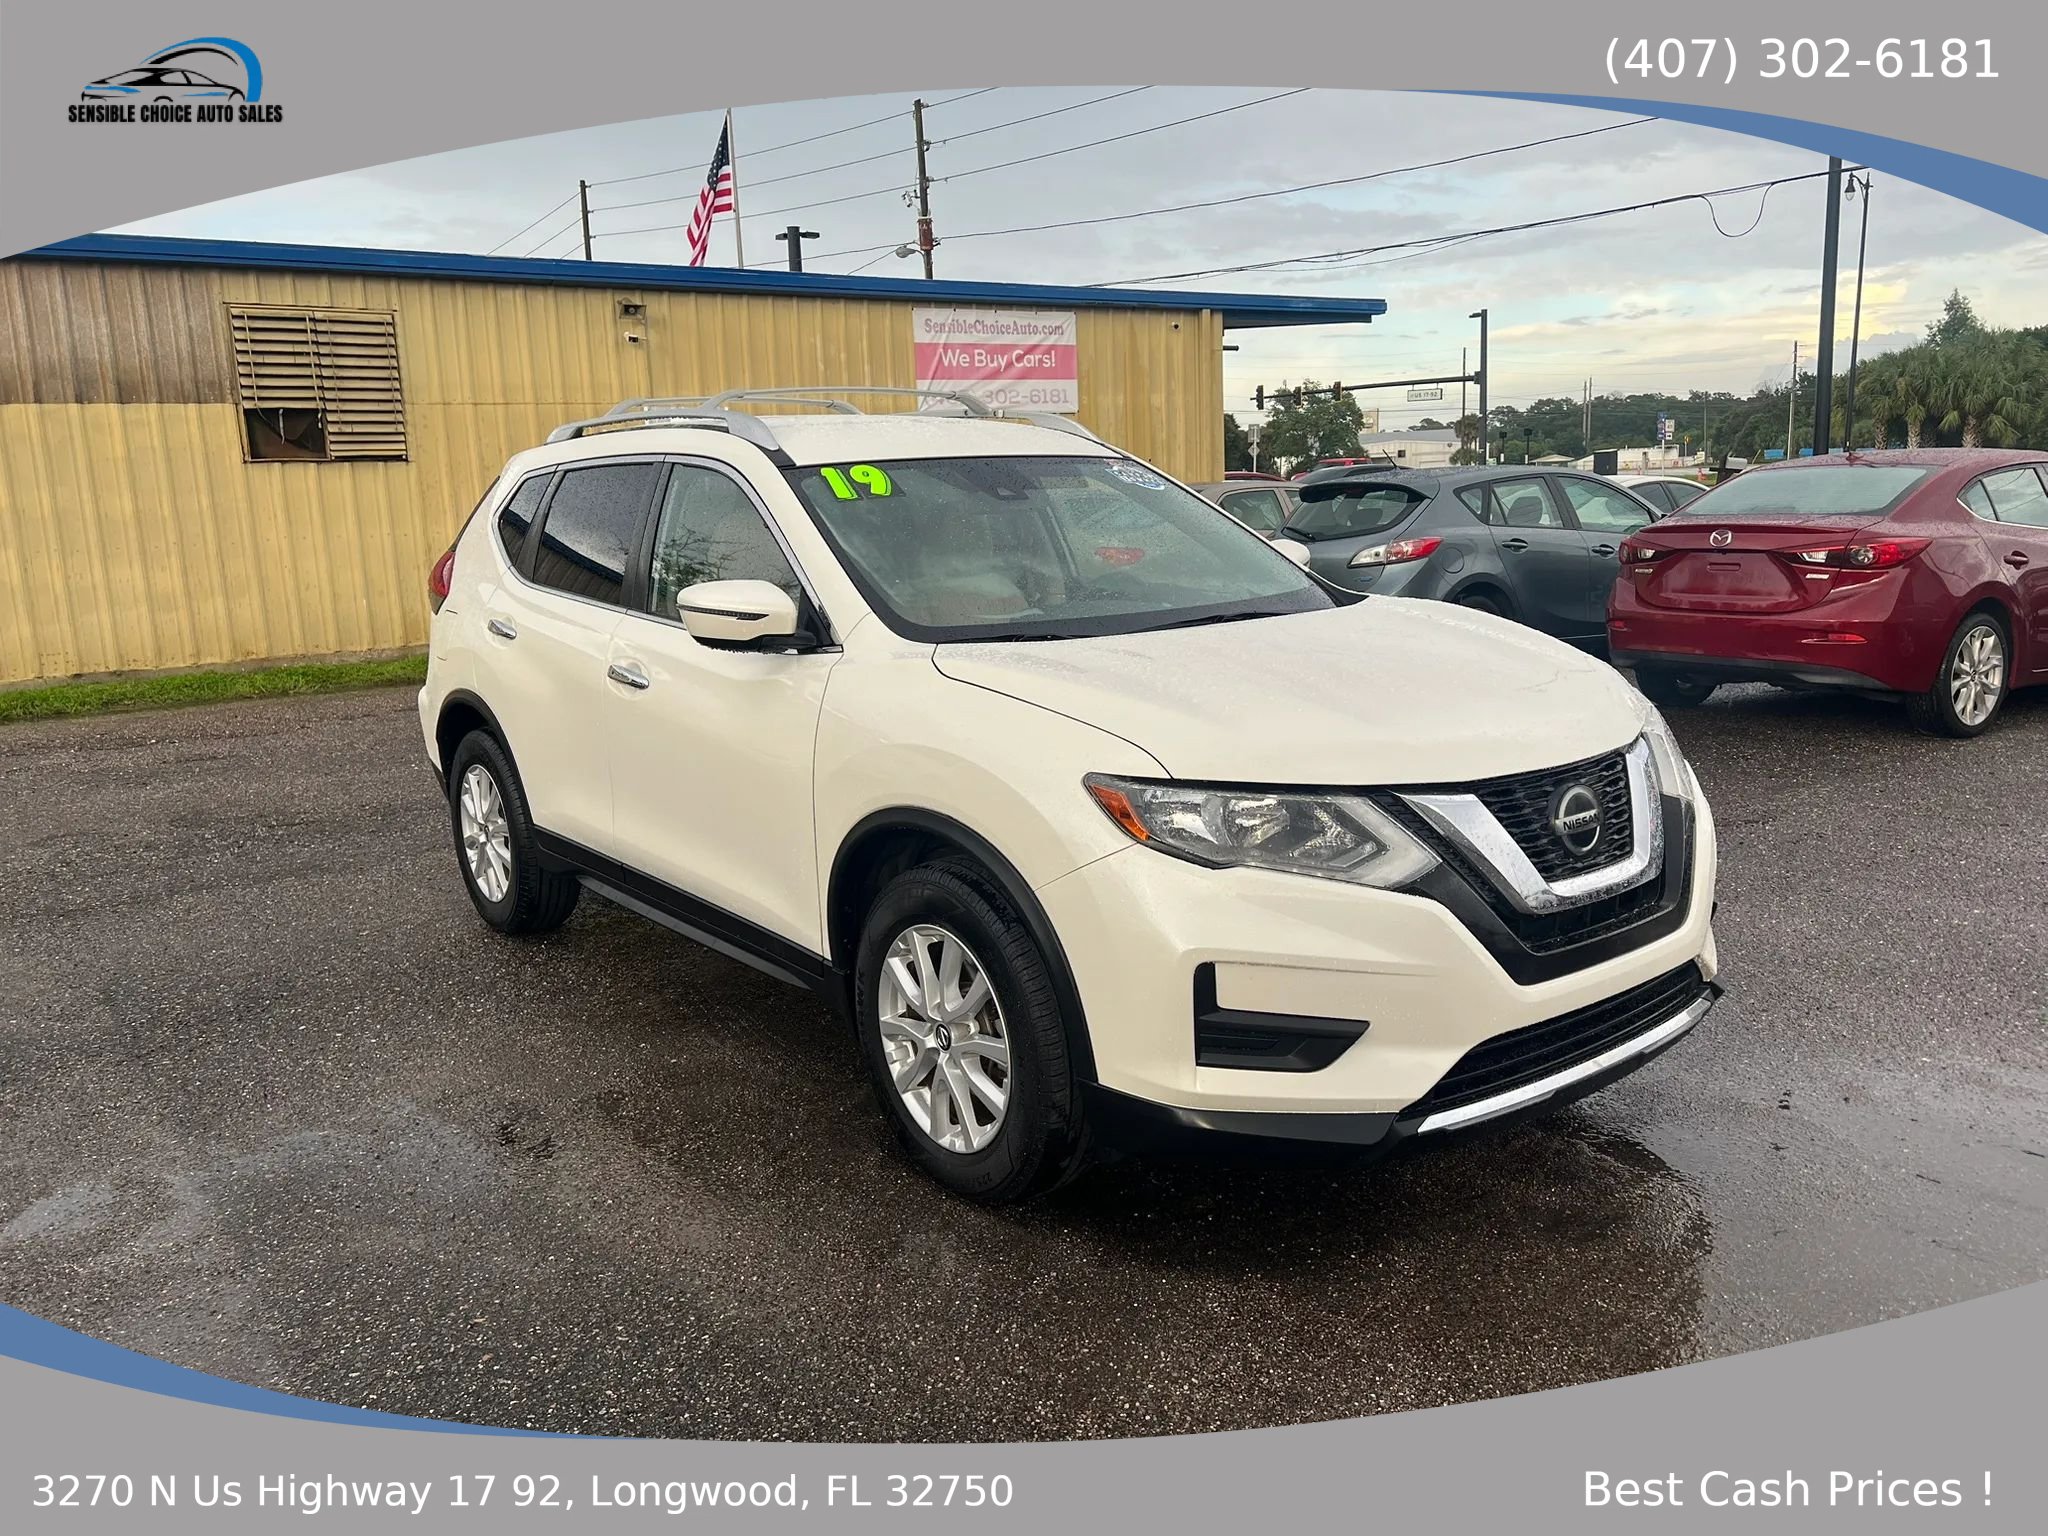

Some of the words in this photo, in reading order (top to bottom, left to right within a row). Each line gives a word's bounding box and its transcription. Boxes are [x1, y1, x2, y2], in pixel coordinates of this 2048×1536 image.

[924, 318, 1064, 336] SensibleChoiceAuto.com
[940, 349, 970, 367] We
[974, 349, 1007, 372] Buy
[1012, 350, 1056, 367] Cars!
[820, 464, 892, 500] 19
[1563, 813, 1600, 831] NISSAN
